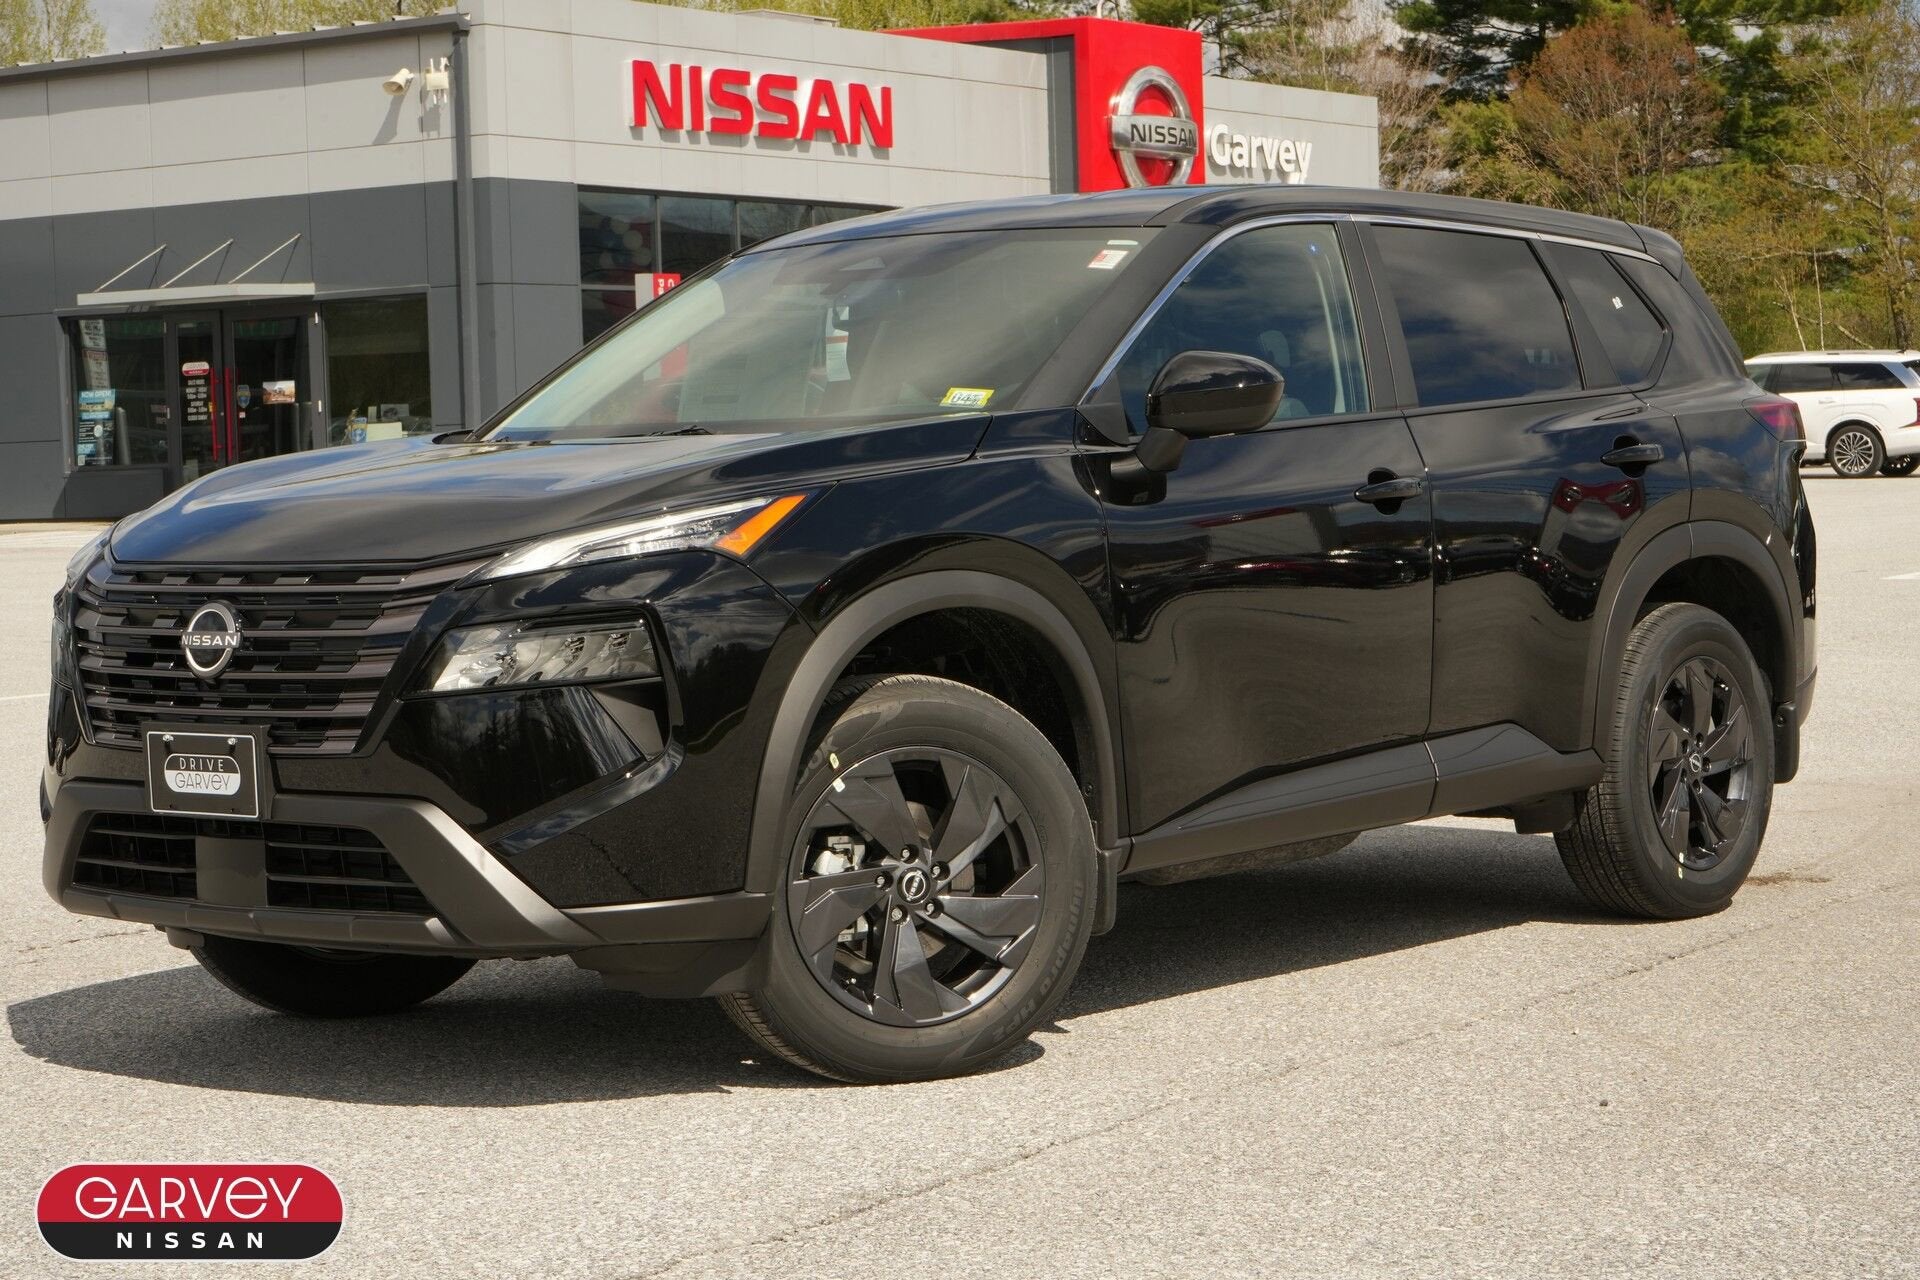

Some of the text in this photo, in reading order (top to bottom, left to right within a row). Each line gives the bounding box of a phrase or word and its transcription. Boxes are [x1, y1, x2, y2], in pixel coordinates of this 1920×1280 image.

[631, 59, 893, 149] NISSAN
[1130, 123, 1197, 150] NISSAN
[1209, 123, 1313, 174] Garvey
[181, 634, 237, 646] NISSAN
[179, 757, 224, 772] DRIVE
